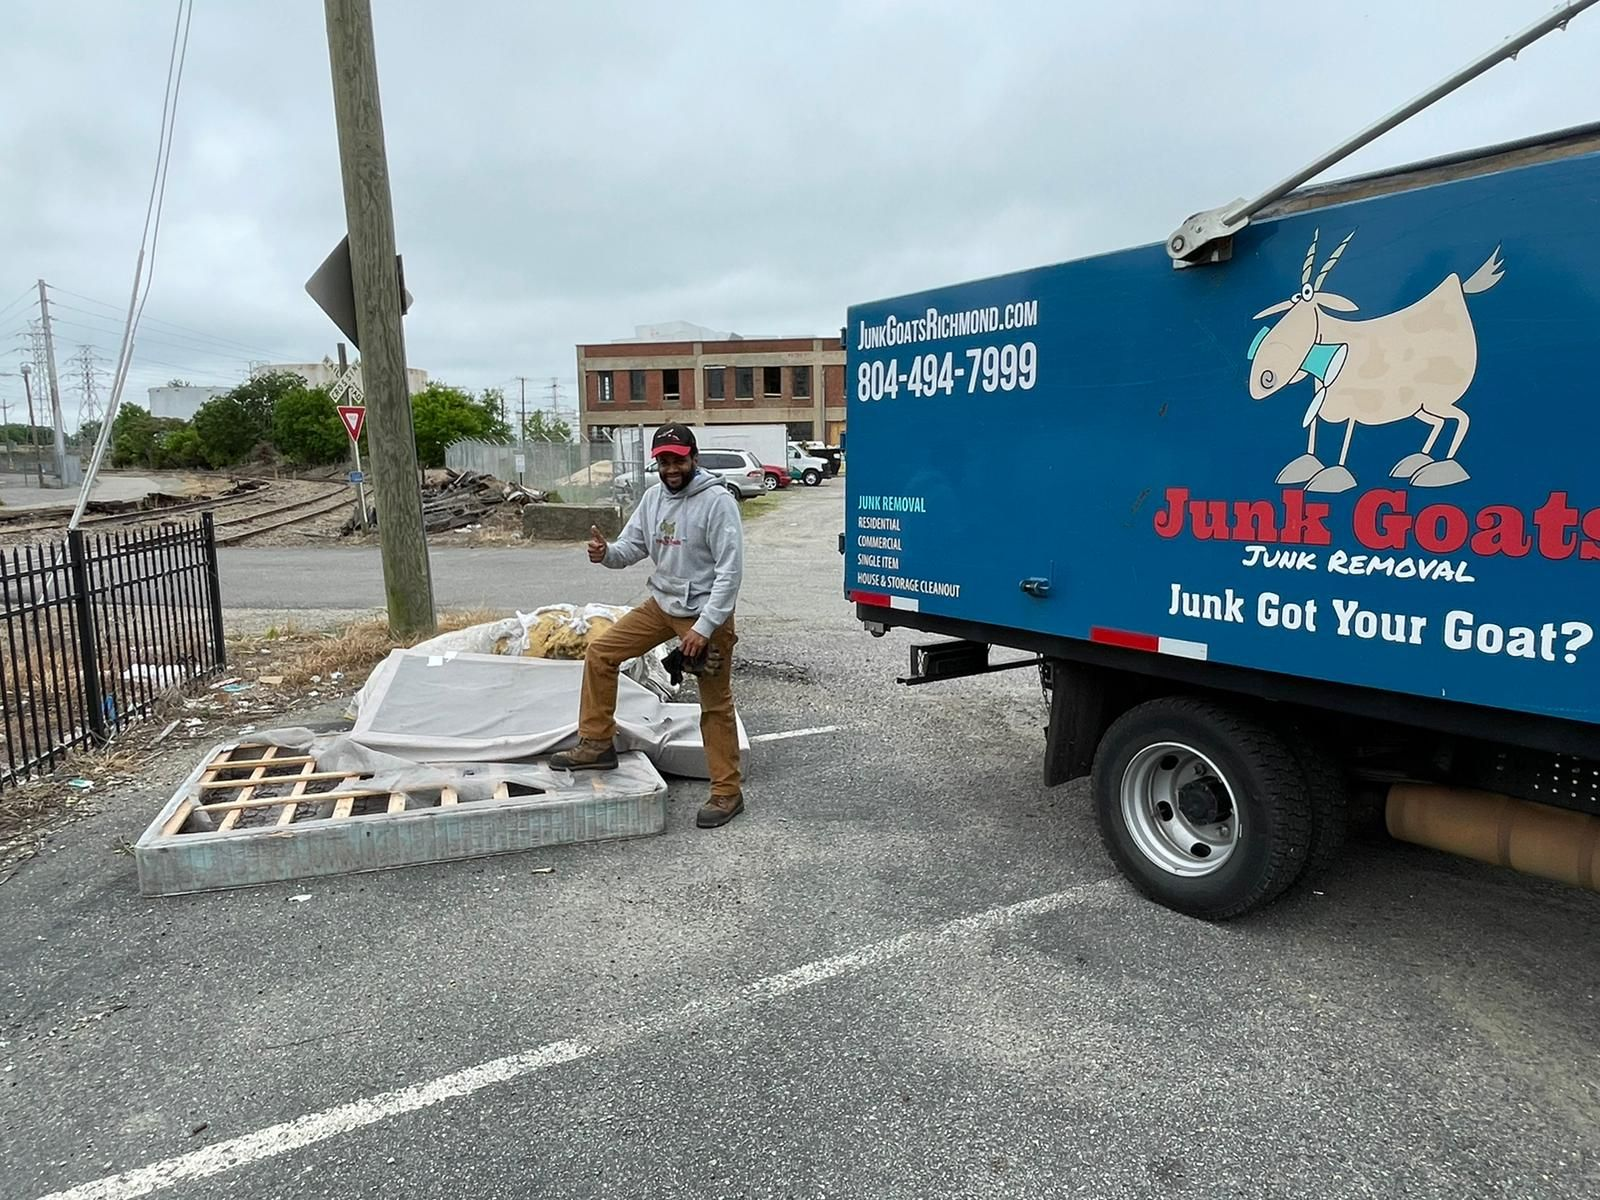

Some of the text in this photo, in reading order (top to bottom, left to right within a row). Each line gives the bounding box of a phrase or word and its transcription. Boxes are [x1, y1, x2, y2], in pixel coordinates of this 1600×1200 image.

[857, 341, 1038, 402] 804-494-7999
[858, 495, 926, 513] JUNK REMOVAL
[1153, 487, 1332, 545] Junk
[858, 516, 901, 531] RESIDENTIAL
[857, 535, 902, 551] COMMERCIAL
[857, 553, 899, 570] SINGLE ITEM
[1242, 545, 1475, 583] JUNK REMOVAL
[857, 572, 960, 598] HOUSE & STORAGE CLEANOUT
[1168, 583, 1594, 664] Junk Got Your Goat?
